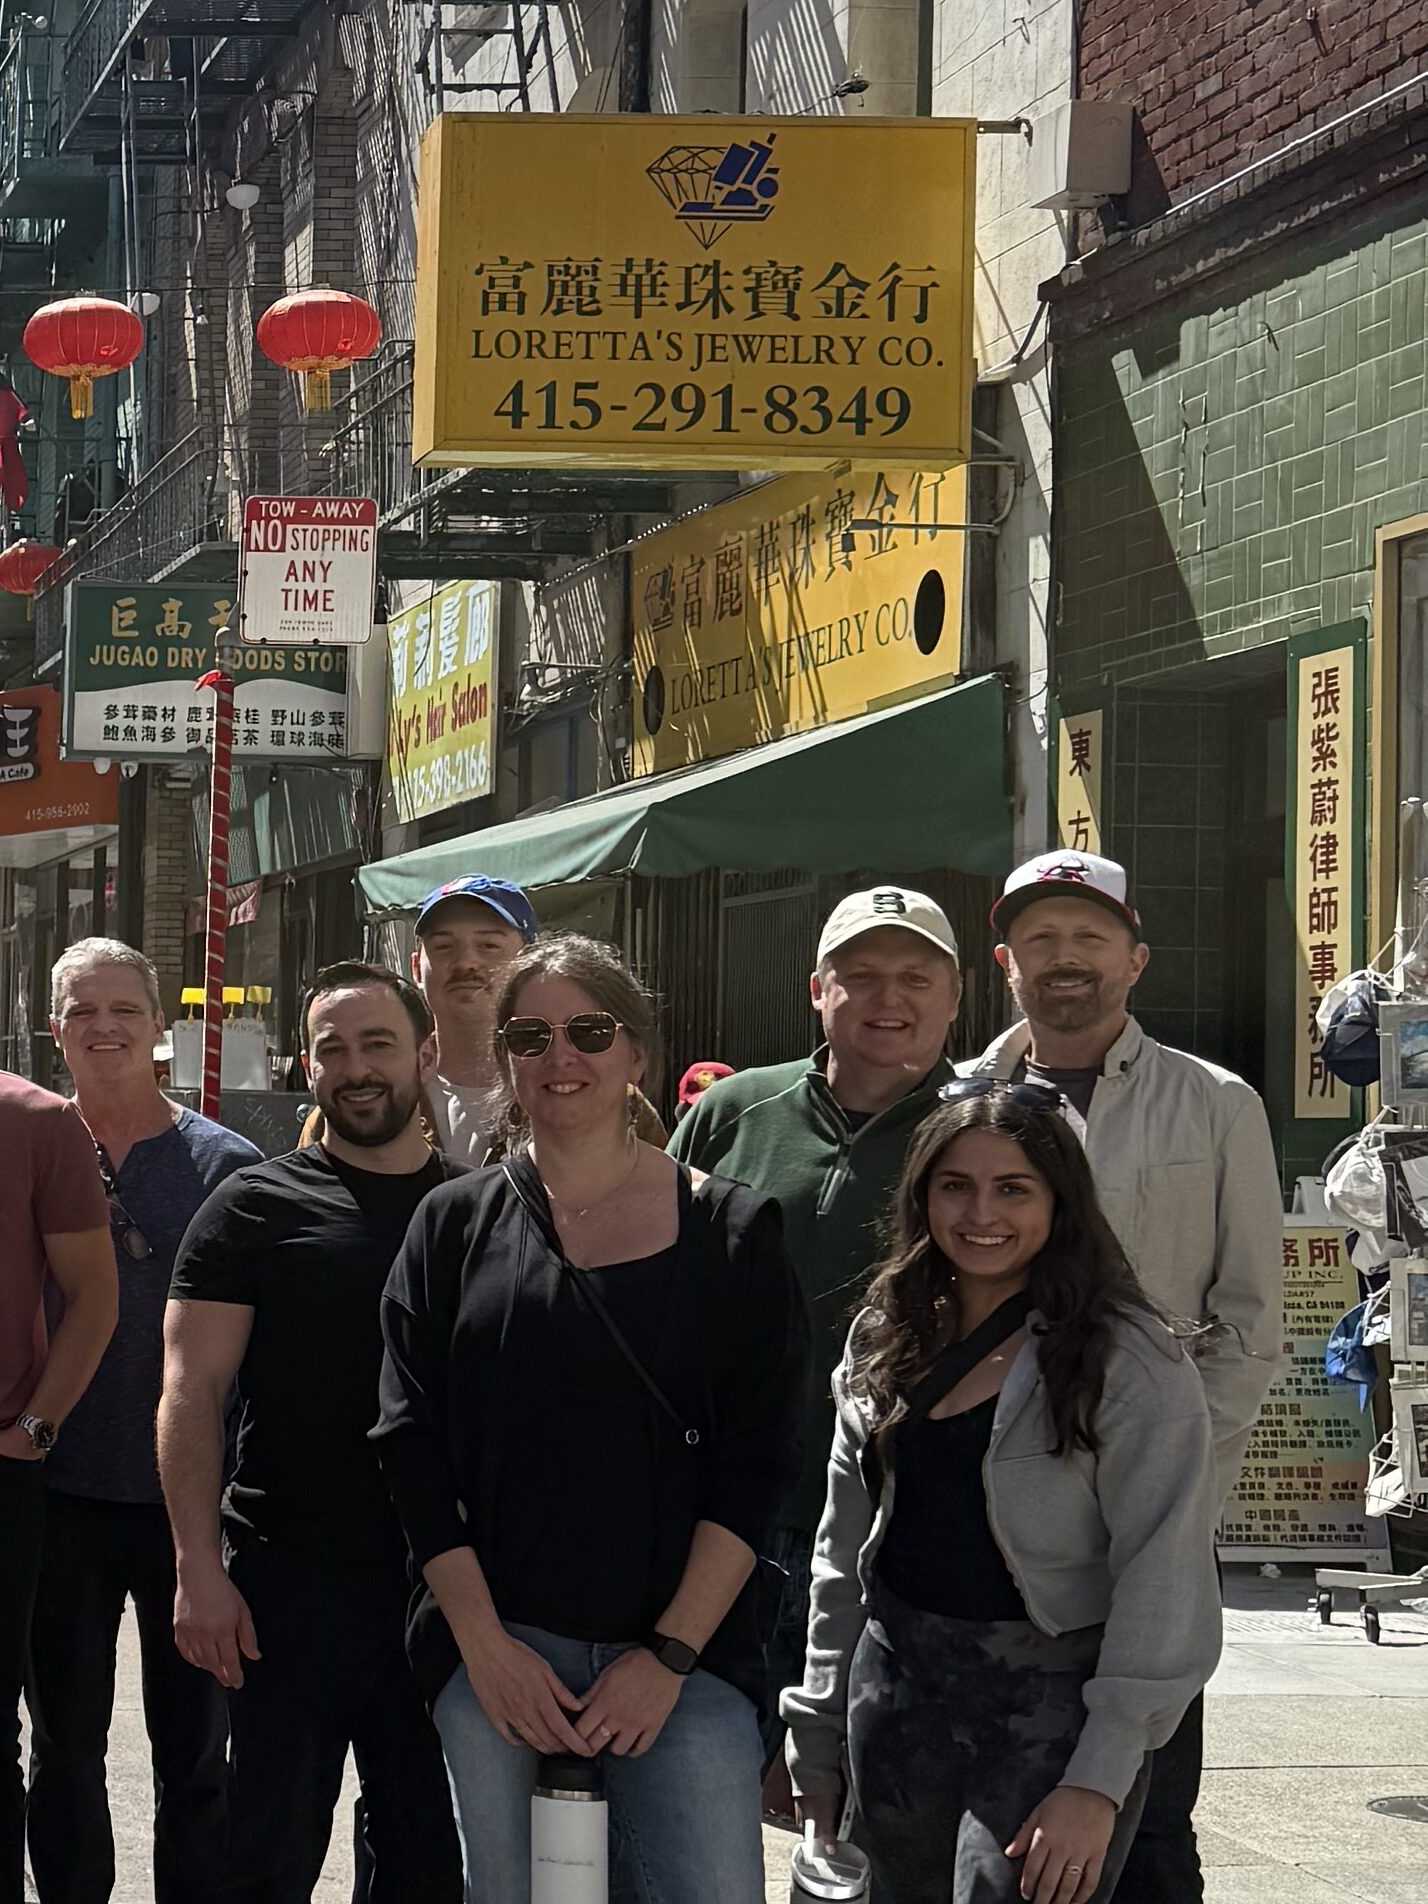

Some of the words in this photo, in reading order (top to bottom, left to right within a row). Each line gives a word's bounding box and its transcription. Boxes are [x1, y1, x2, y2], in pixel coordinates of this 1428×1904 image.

[474, 256, 942, 324] 富麗華珠寶金行
[471, 328, 682, 363] LORETTA'S
[689, 331, 870, 372] JEWELRY
[878, 337, 945, 368] CO.
[493, 379, 912, 437] 415-291-8349
[250, 519, 283, 550] NO
[290, 527, 370, 553] STOPPING
[284, 560, 334, 583] ANY
[280, 588, 335, 612] TIME
[89, 645, 158, 668] JUGAO
[167, 648, 206, 669] DRY
[233, 649, 285, 671] OODS
[294, 650, 347, 673] STOR
[670, 645, 772, 716] LORETTA'S
[775, 610, 869, 695] JEWELRY
[451, 672, 488, 733] Salon
